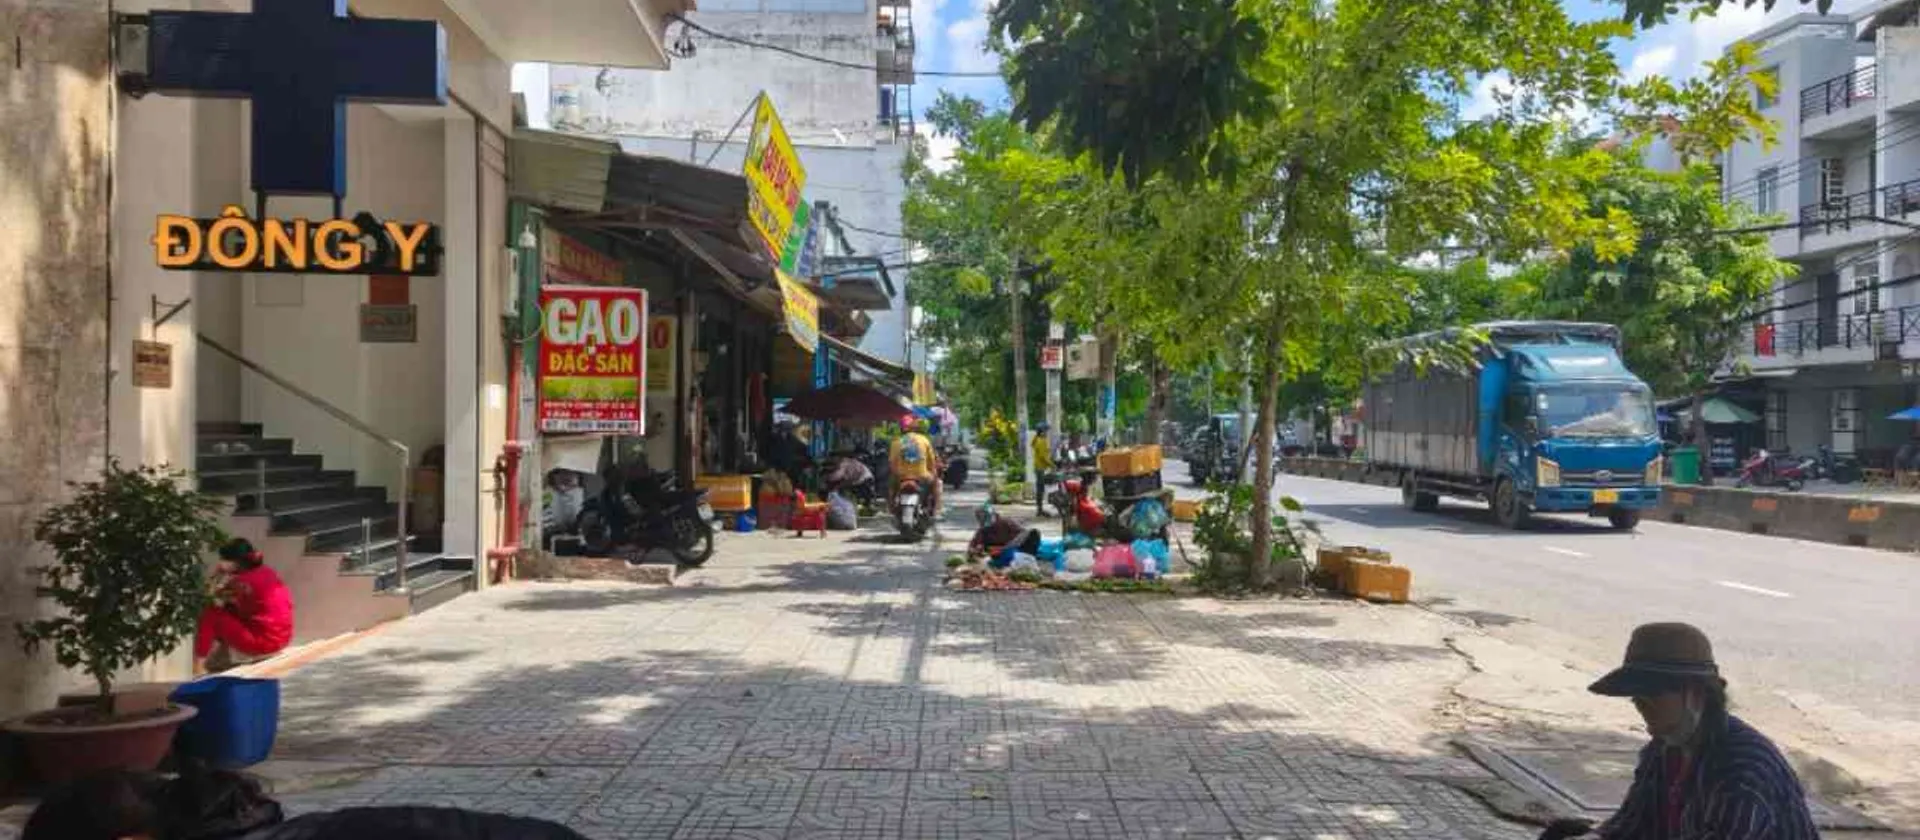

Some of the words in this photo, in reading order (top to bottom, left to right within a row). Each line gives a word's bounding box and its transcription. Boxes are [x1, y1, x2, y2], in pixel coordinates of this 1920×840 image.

[152, 204, 362, 271] ĐÔNG
[384, 219, 429, 271] Y
[546, 298, 639, 355] GẠO
[549, 349, 590, 376] ĐẶC
[596, 347, 634, 374] SẢN
